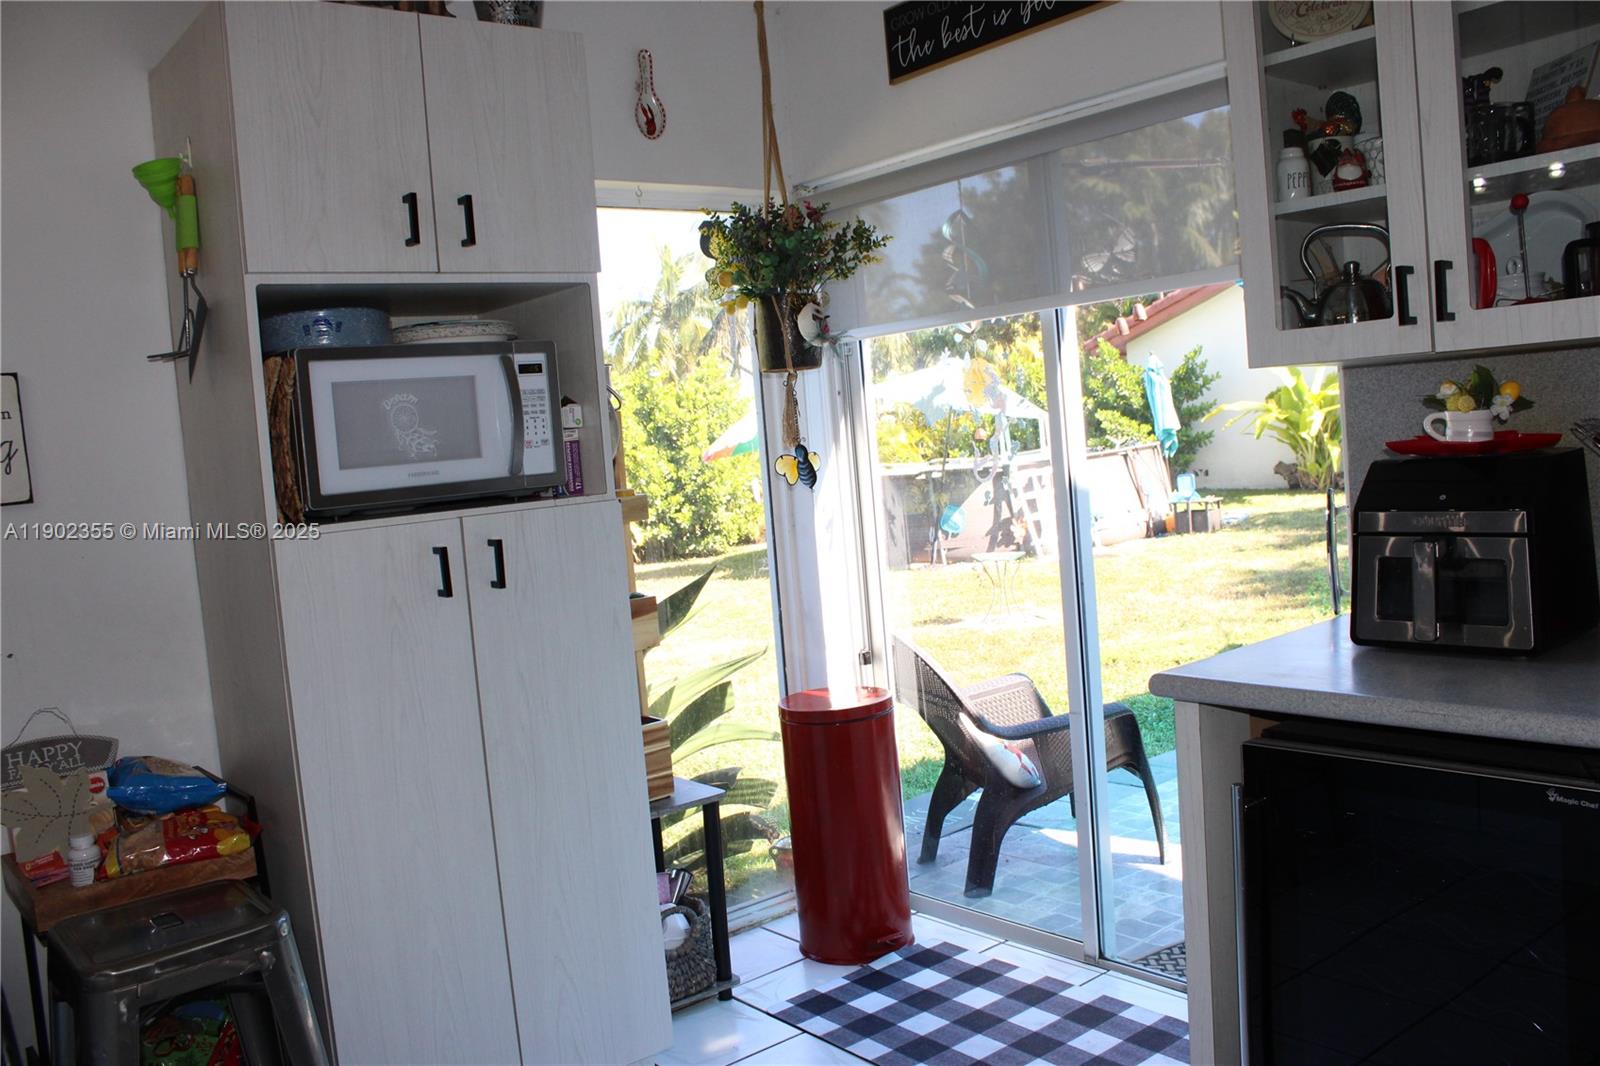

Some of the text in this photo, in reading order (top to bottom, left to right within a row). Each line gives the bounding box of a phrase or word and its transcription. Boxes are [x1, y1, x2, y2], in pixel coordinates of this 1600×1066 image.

[891, 27, 935, 67] the
[941, 2, 986, 49] best
[993, 8, 1012, 26] is
[5, 741, 82, 769] HAPPY
